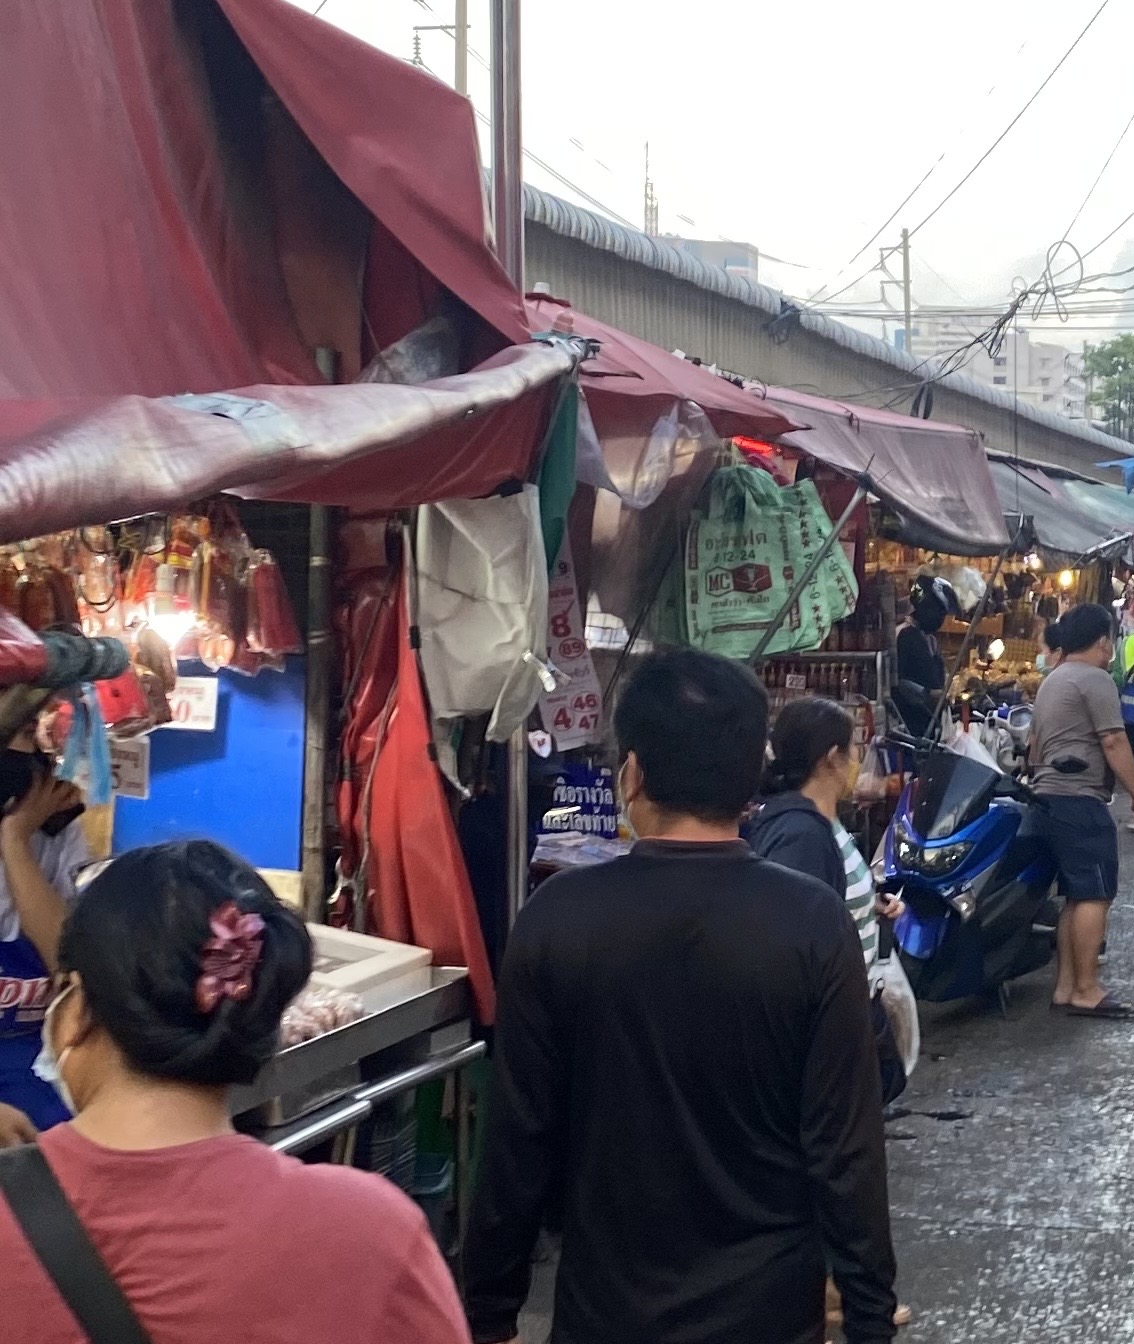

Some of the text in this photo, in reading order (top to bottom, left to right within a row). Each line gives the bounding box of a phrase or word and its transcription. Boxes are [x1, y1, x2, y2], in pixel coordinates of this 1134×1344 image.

[708, 574, 731, 592] MC
[574, 694, 597, 710] 46
[554, 708, 571, 730] 4
[579, 714, 599, 730] 47
